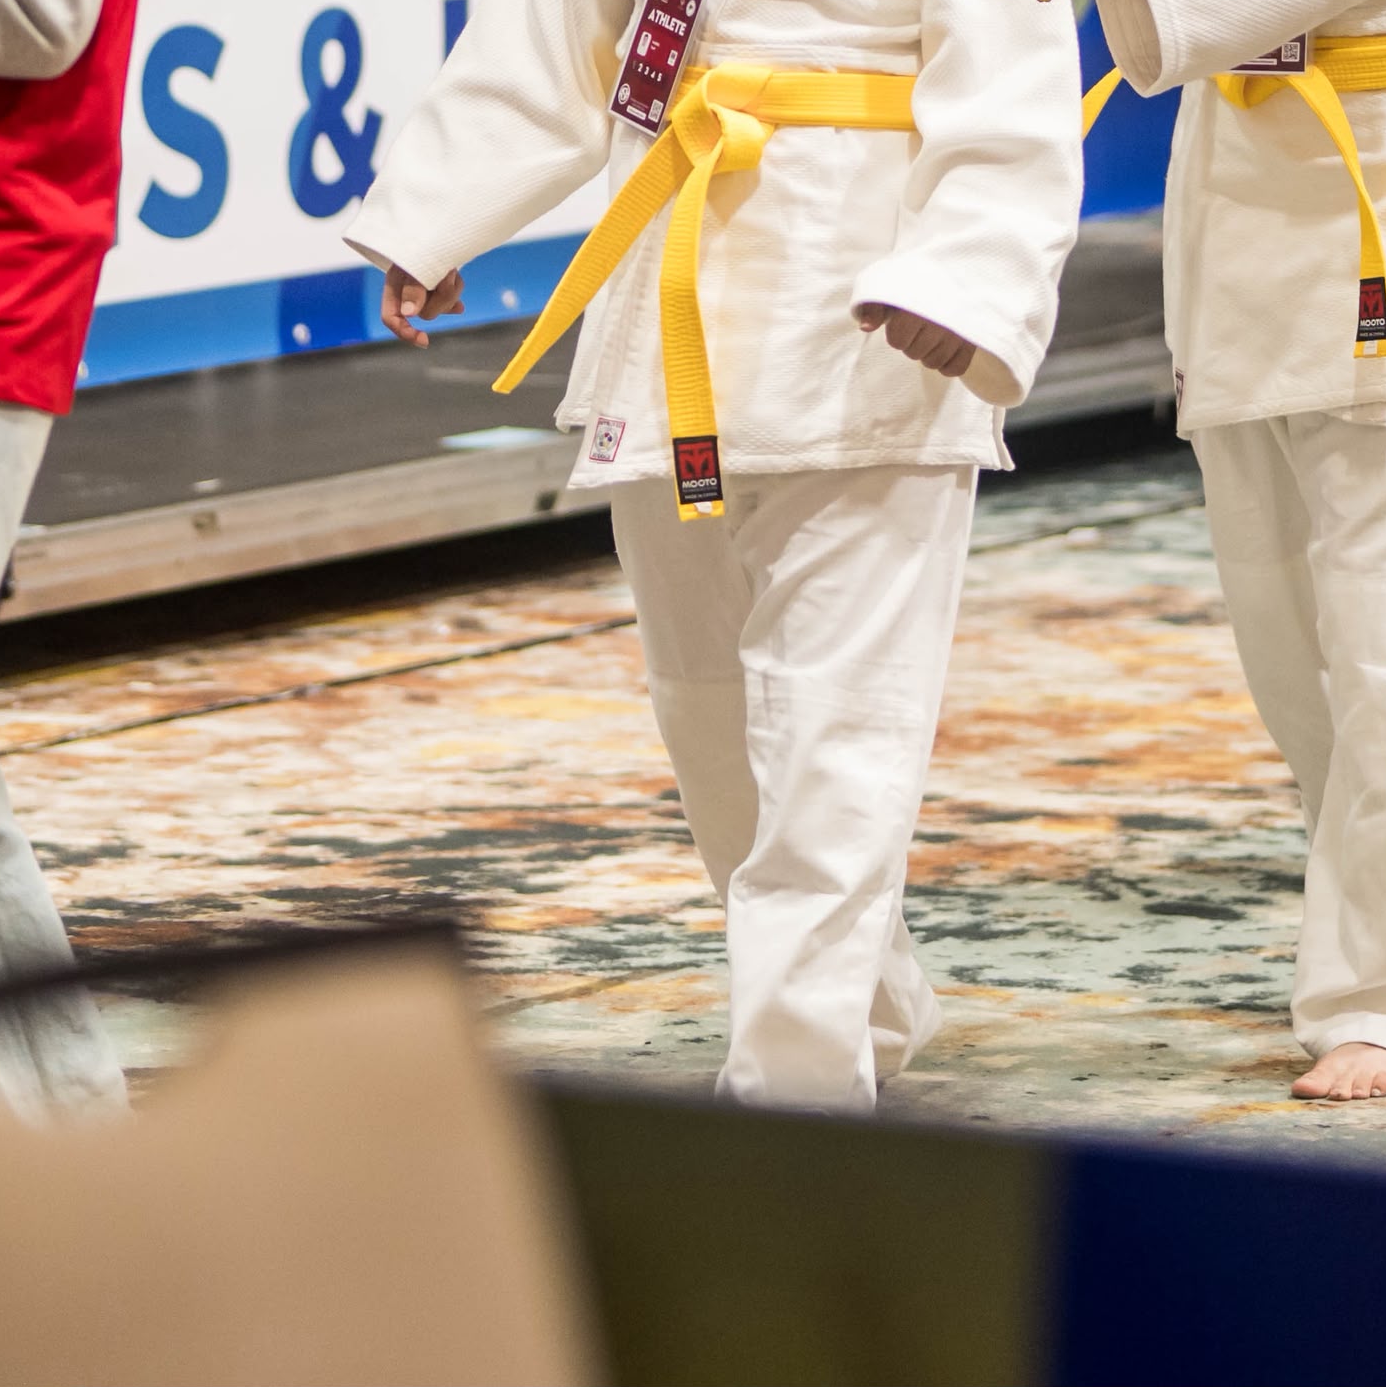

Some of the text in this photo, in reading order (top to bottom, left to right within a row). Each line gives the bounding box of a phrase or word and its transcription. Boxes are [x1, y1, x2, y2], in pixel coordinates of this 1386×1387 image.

[647, 8, 688, 37] ATHLETE
[1360, 318, 1386, 327] MOOTO
[682, 478, 717, 488] MOOTO
